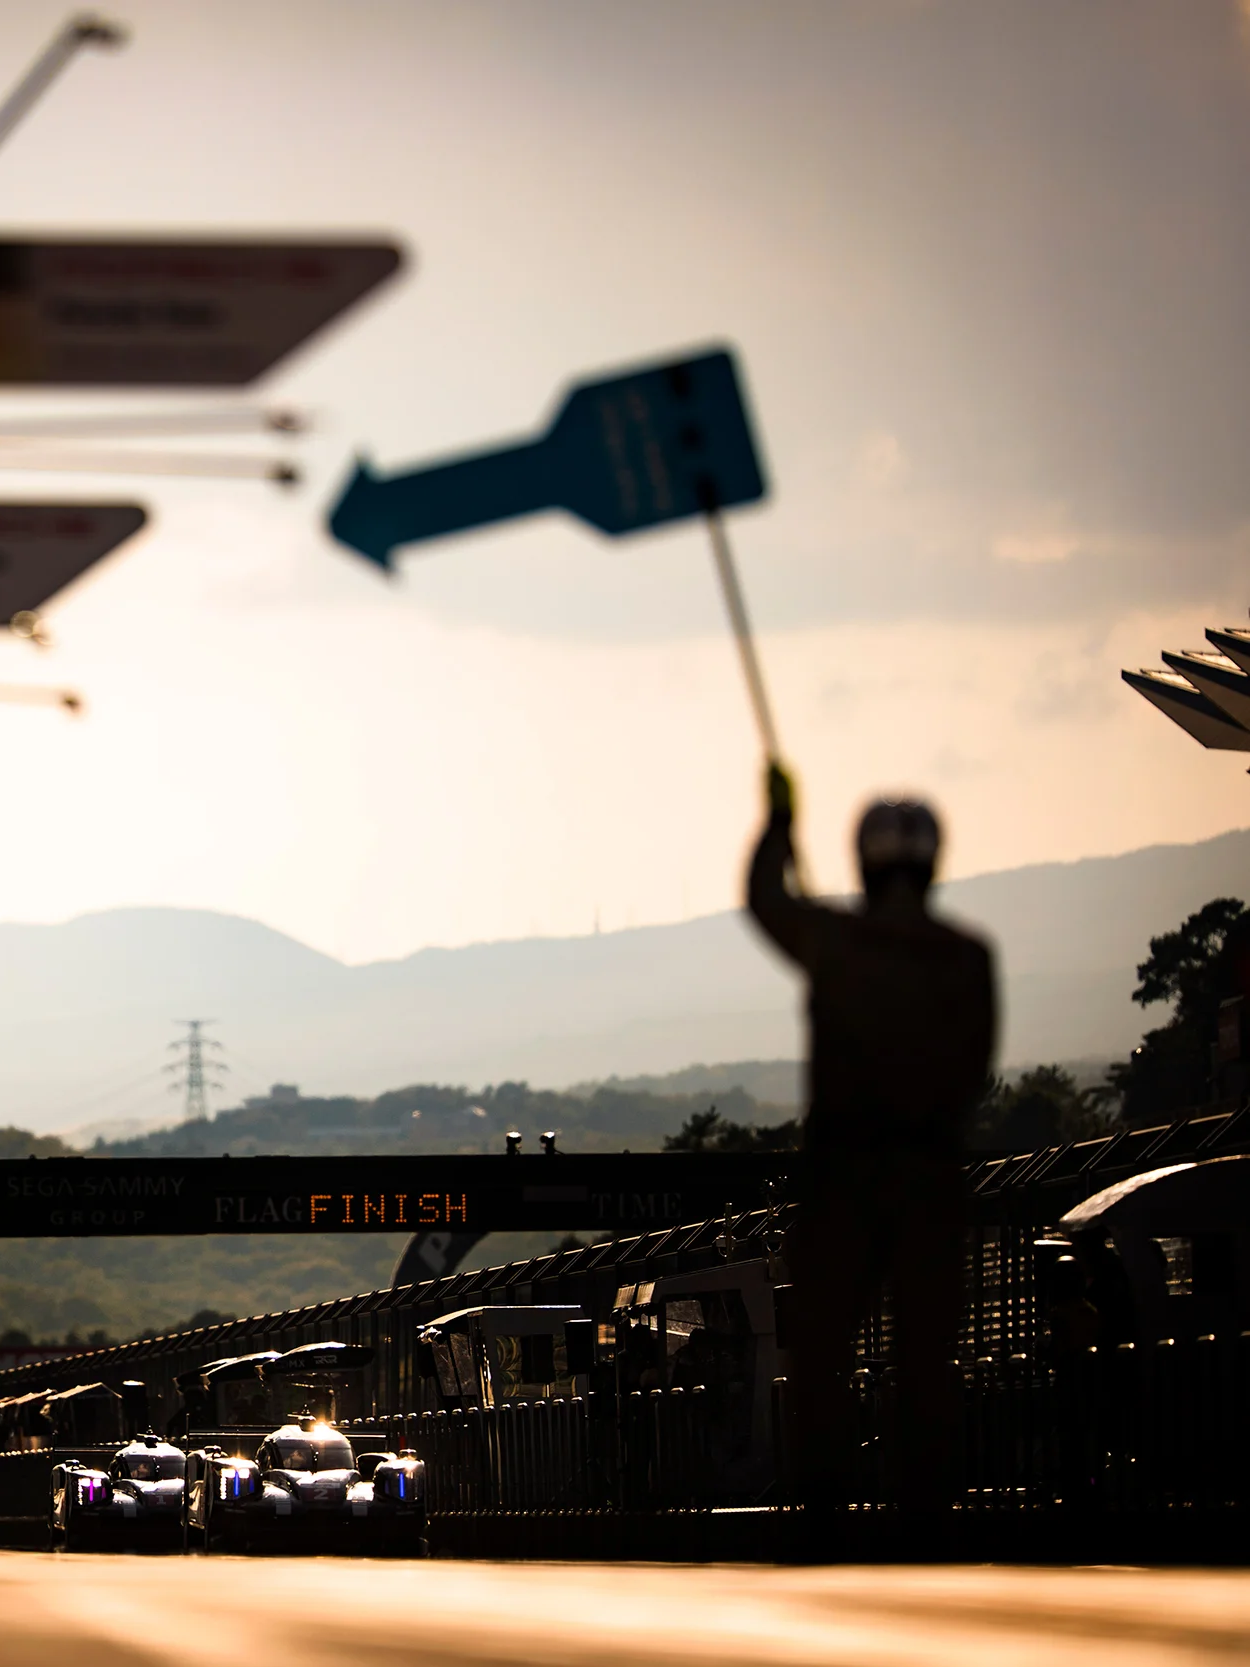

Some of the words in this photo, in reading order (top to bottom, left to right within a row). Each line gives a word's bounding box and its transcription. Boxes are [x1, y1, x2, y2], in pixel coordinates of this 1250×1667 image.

[6, 1175, 74, 1198] SEGA
[49, 1209, 146, 1226] GROUP
[213, 1196, 303, 1224] FLAG
[309, 1193, 467, 1224] FINISH
[590, 1191, 683, 1220] TIME
